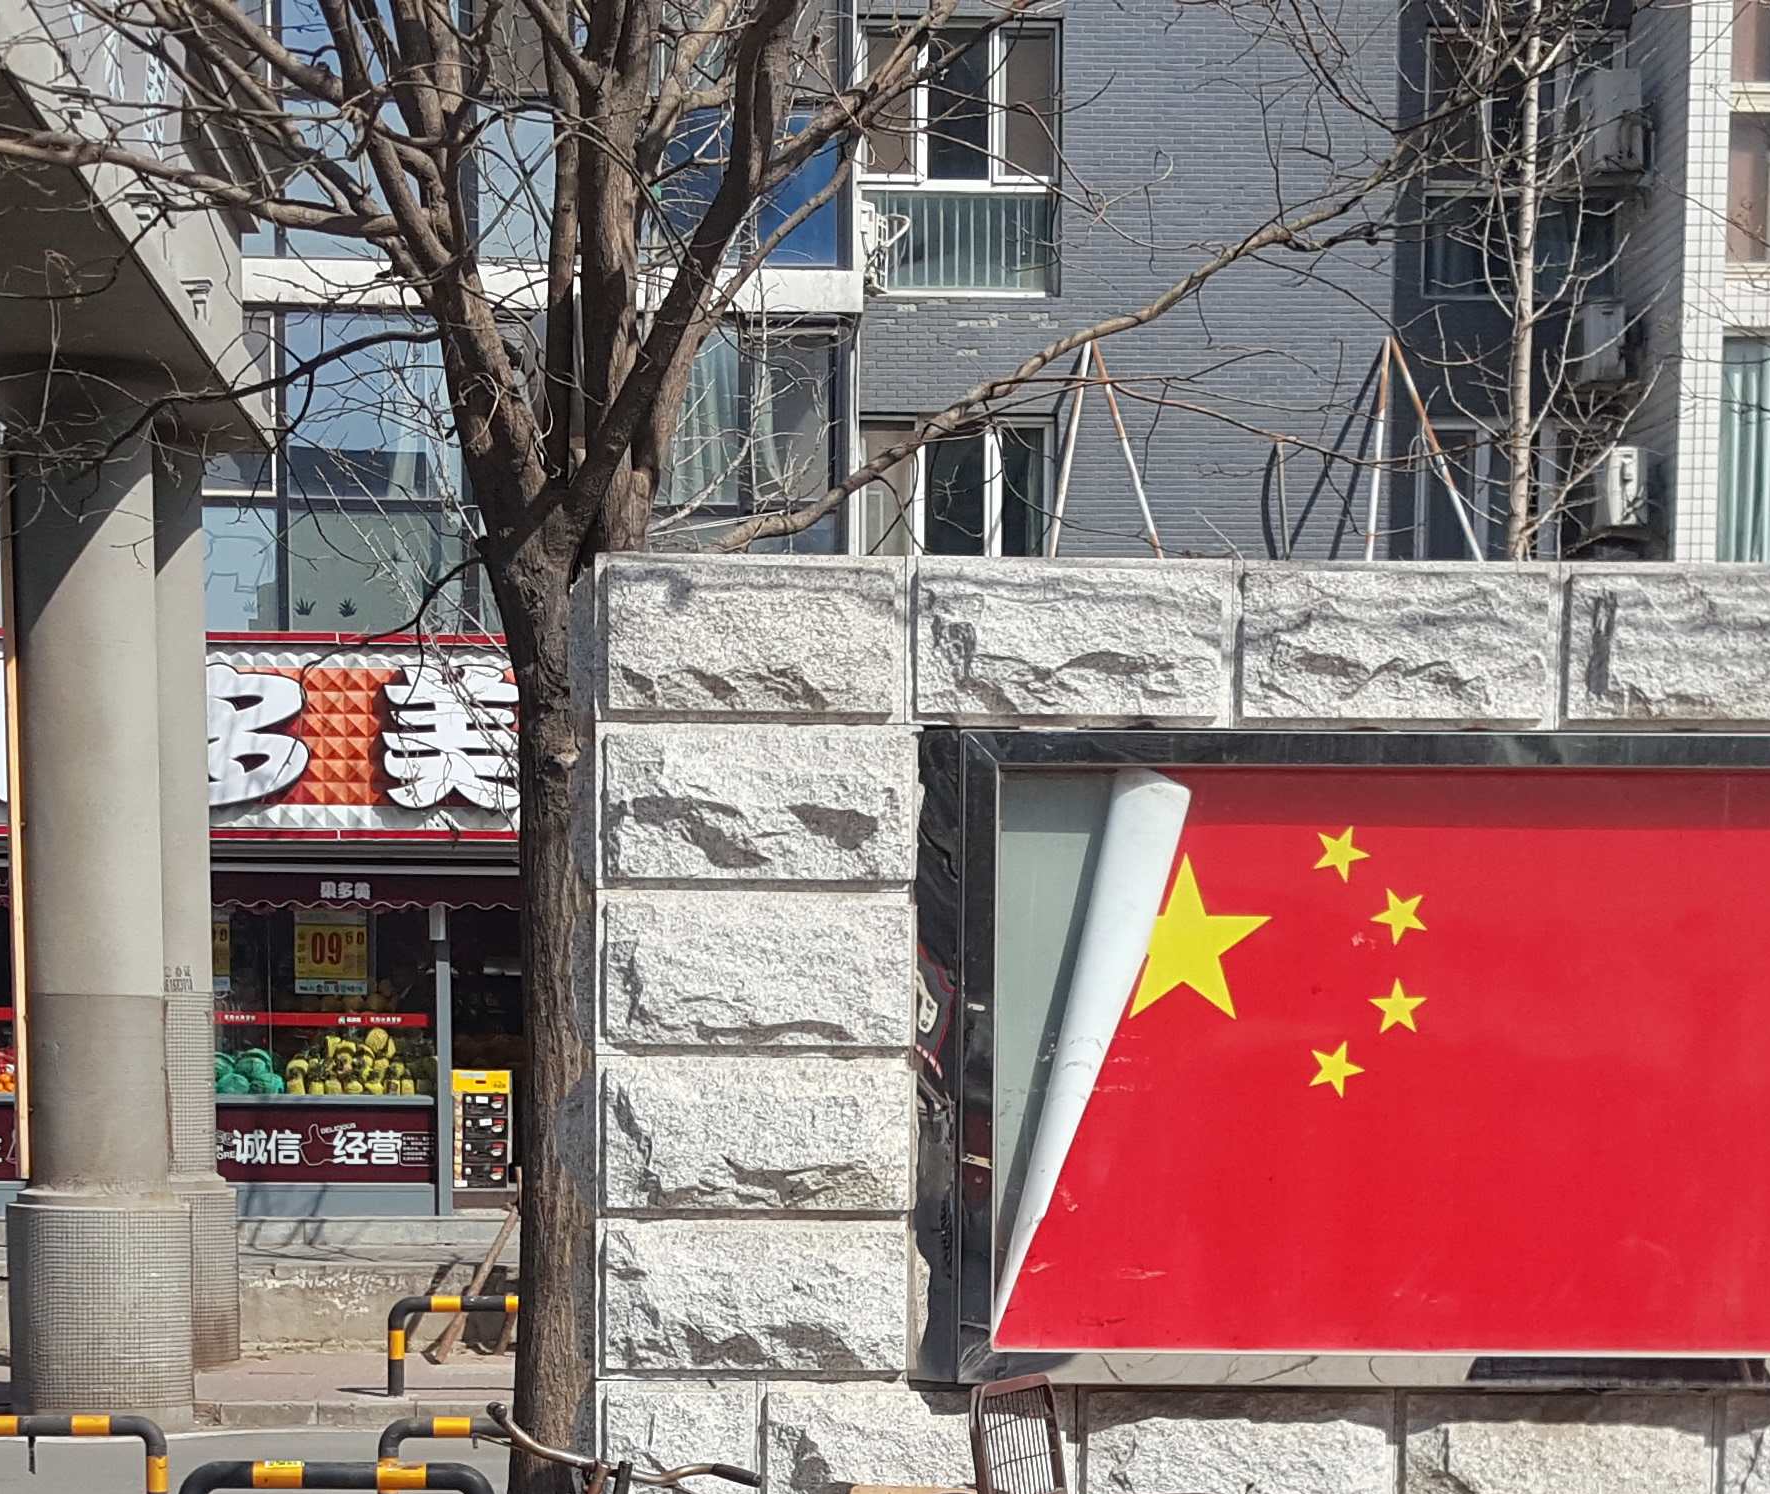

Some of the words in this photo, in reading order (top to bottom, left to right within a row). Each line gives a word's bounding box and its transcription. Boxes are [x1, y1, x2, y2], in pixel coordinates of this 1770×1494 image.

[312, 932, 342, 965] 09
[232, 1128, 302, 1165] 诚信
[333, 1130, 403, 1165] 经营
